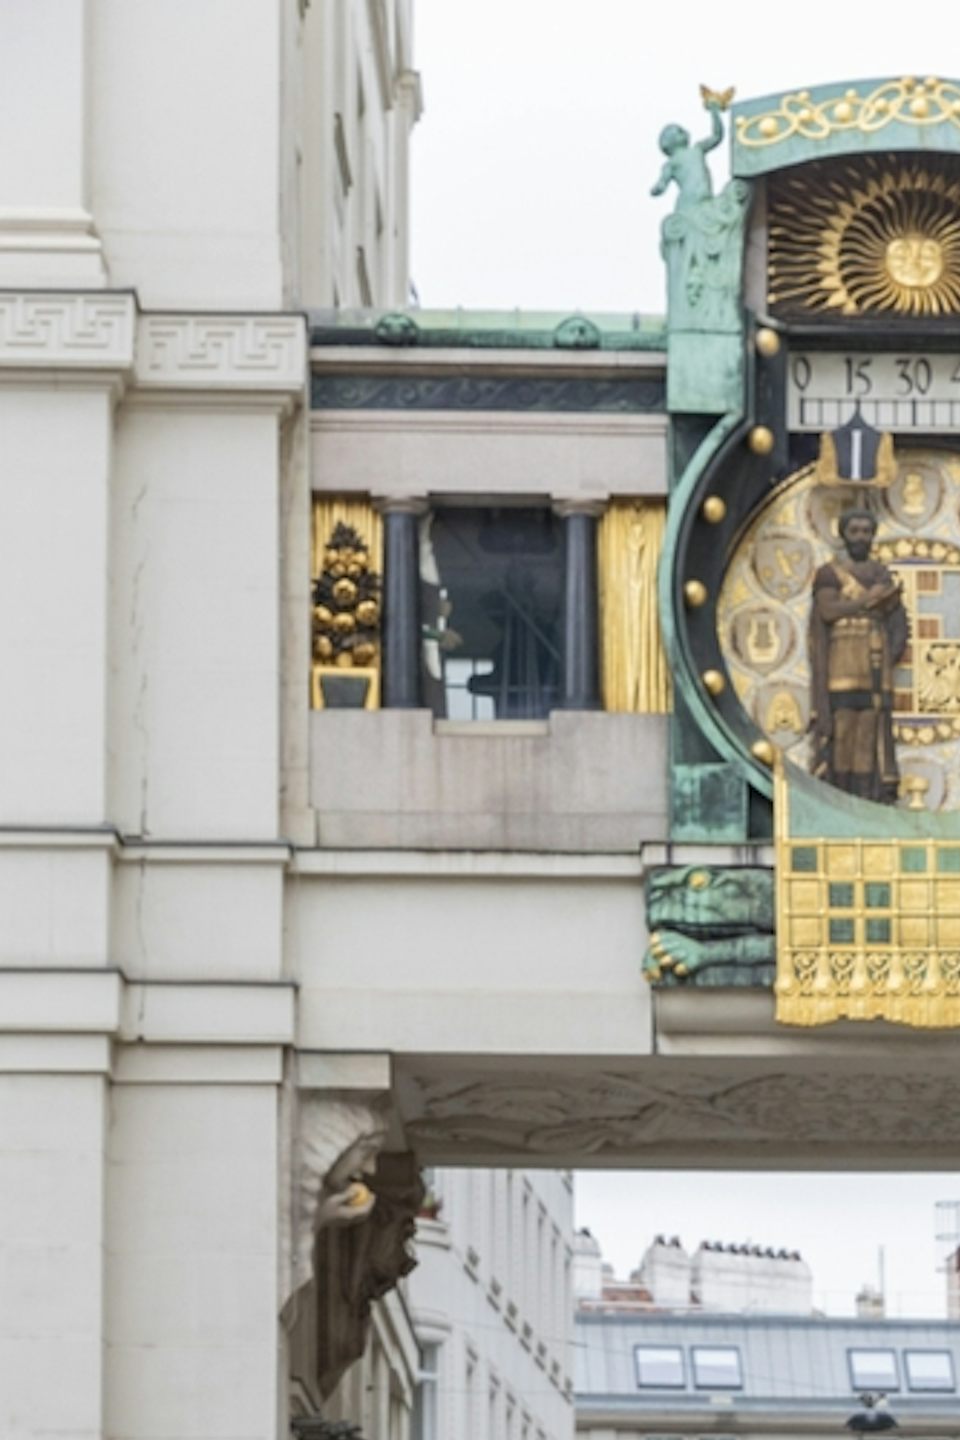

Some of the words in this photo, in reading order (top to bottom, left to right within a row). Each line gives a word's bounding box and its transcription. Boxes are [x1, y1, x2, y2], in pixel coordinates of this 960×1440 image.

[792, 357, 811, 391] 0
[844, 357, 873, 396] 15
[896, 357, 932, 396] 30
